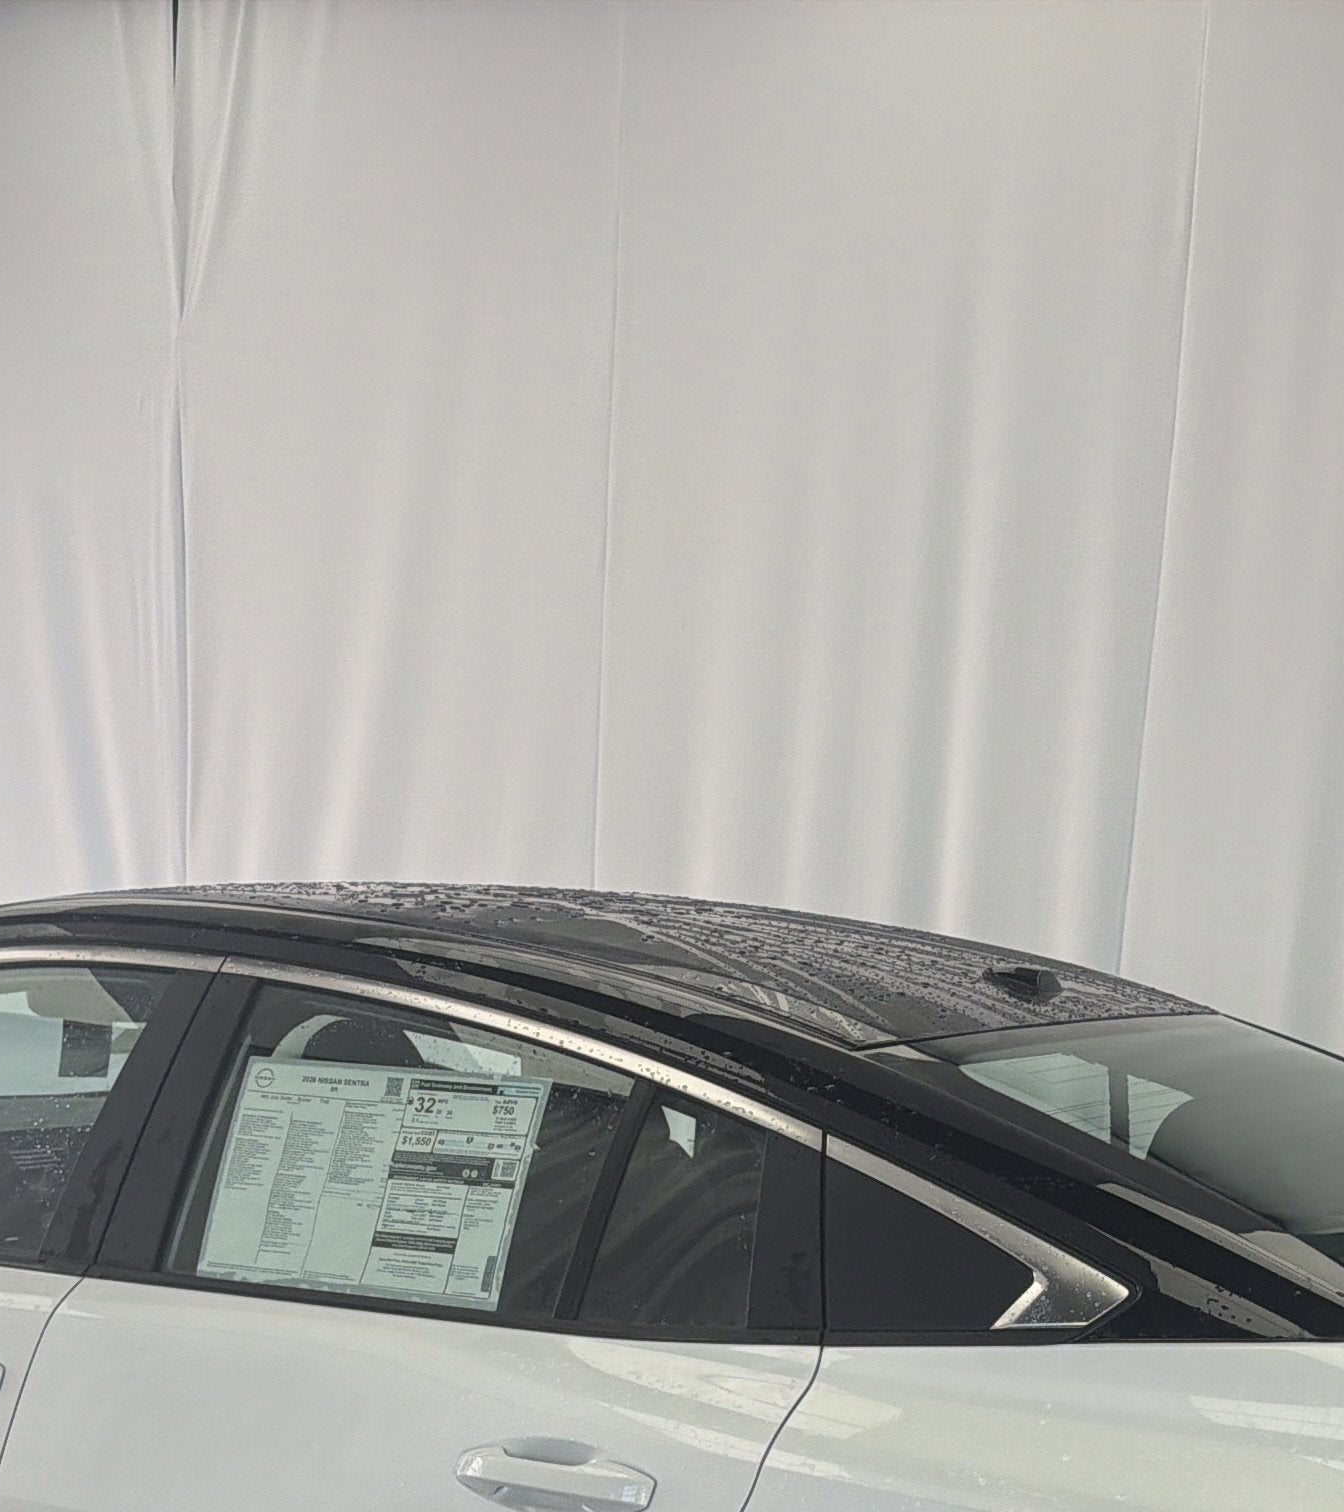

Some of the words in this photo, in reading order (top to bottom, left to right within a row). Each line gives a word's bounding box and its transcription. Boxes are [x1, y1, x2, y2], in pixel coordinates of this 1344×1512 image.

[317, 1077, 343, 1085] NISSAN
[343, 1078, 370, 1087] SENTRA
[414, 1096, 437, 1114] 32
[492, 1105, 515, 1116] $750
[401, 1135, 432, 1147] $1,550
